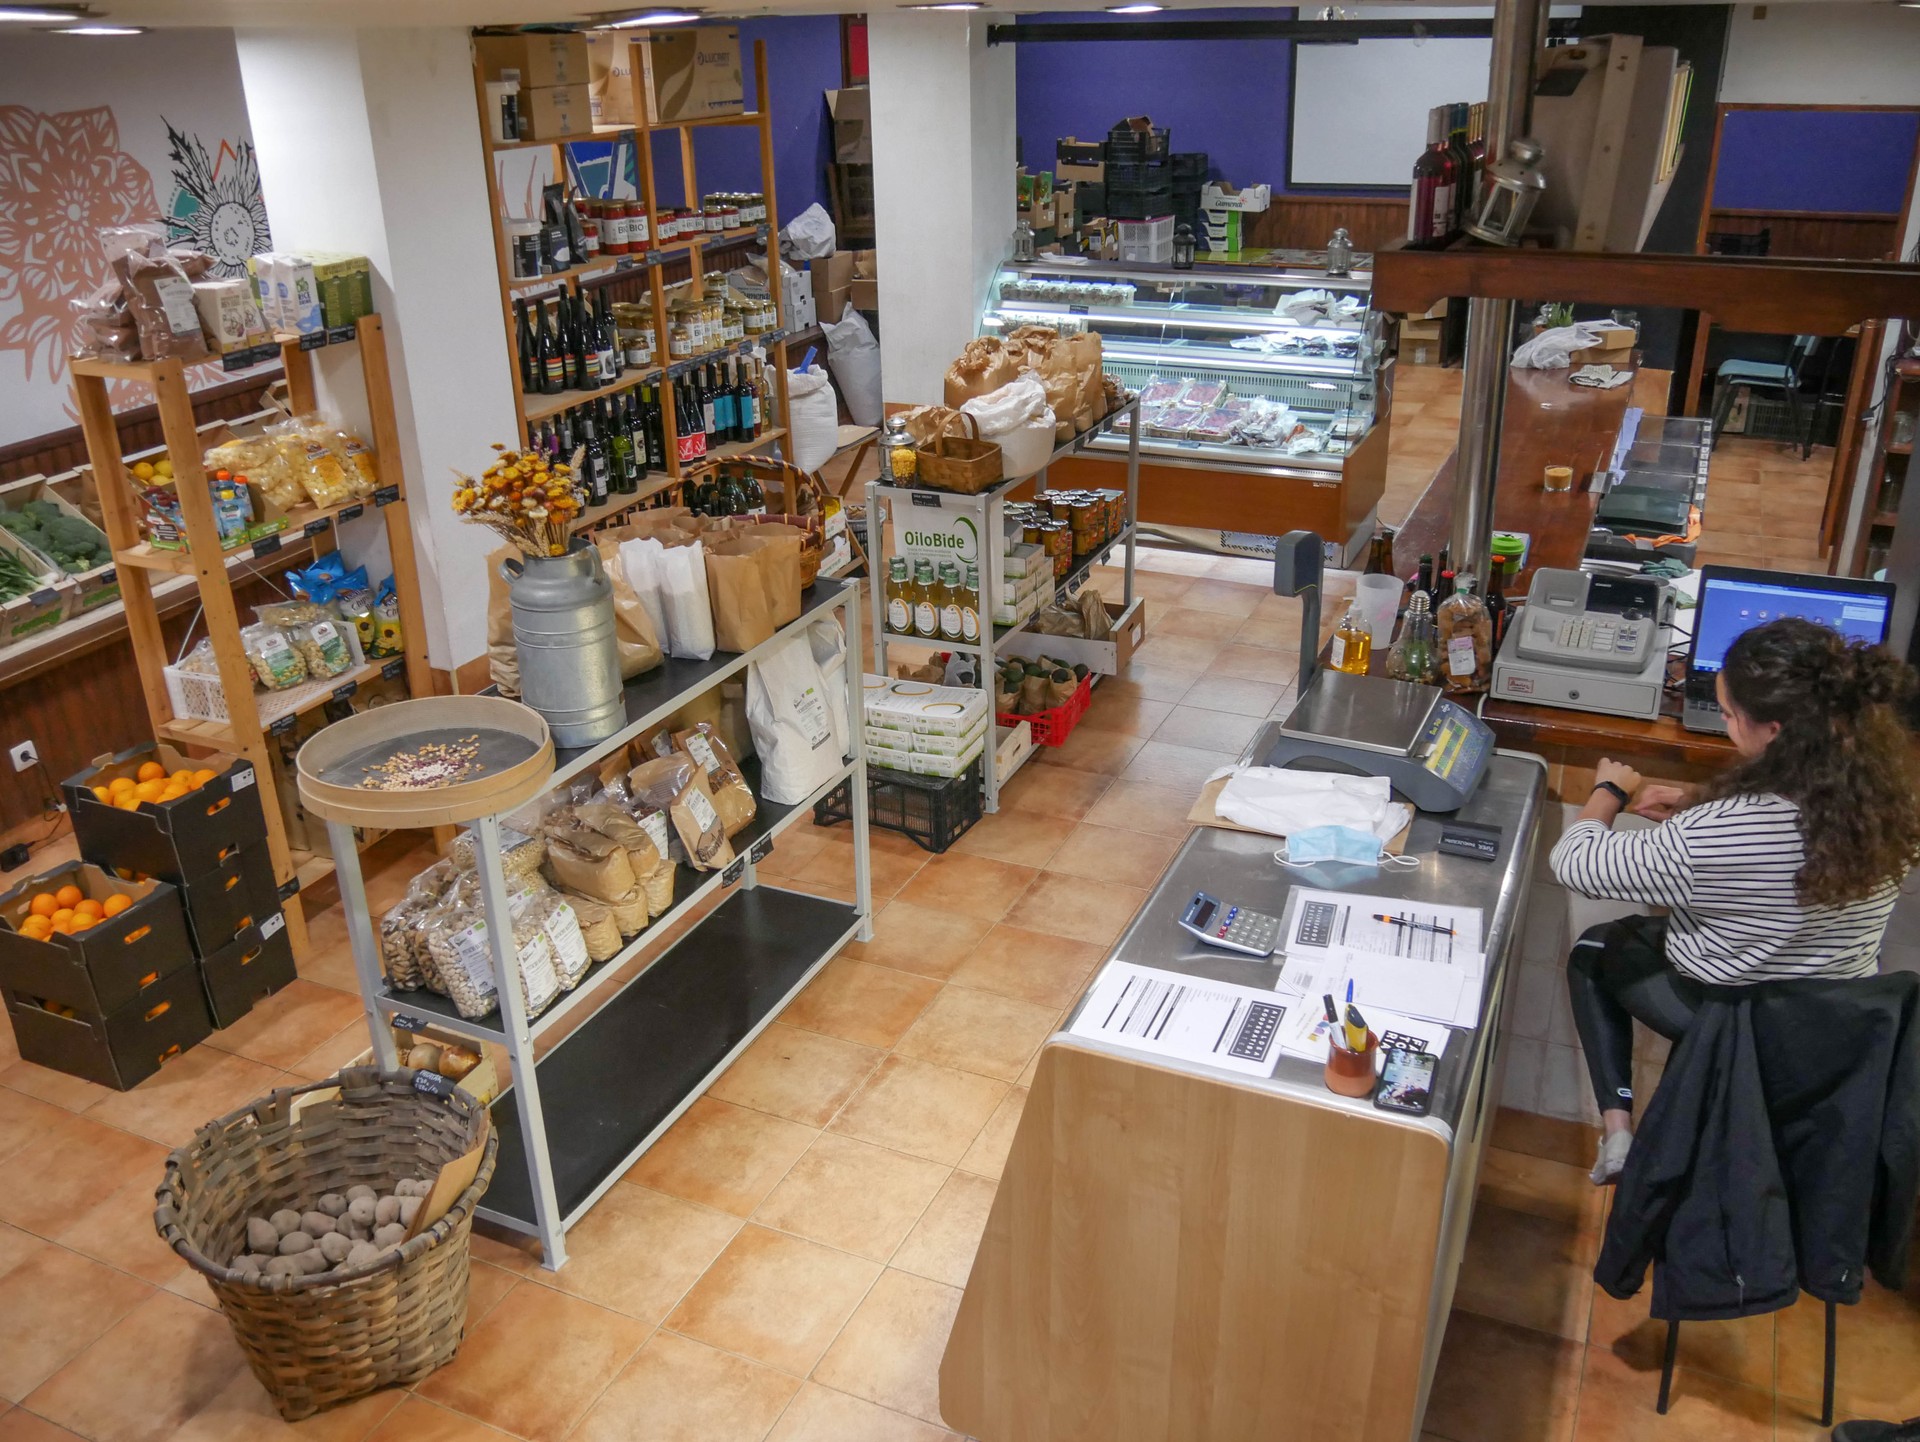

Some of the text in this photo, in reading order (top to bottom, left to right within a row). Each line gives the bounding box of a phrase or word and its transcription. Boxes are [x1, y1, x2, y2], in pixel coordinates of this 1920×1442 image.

[629, 223, 644, 232] BIO
[904, 531, 965, 549] OiloBide
[1244, 1008, 1270, 1054] KOOPERATIBA
[1254, 1010, 1278, 1056] AIARALDEA
